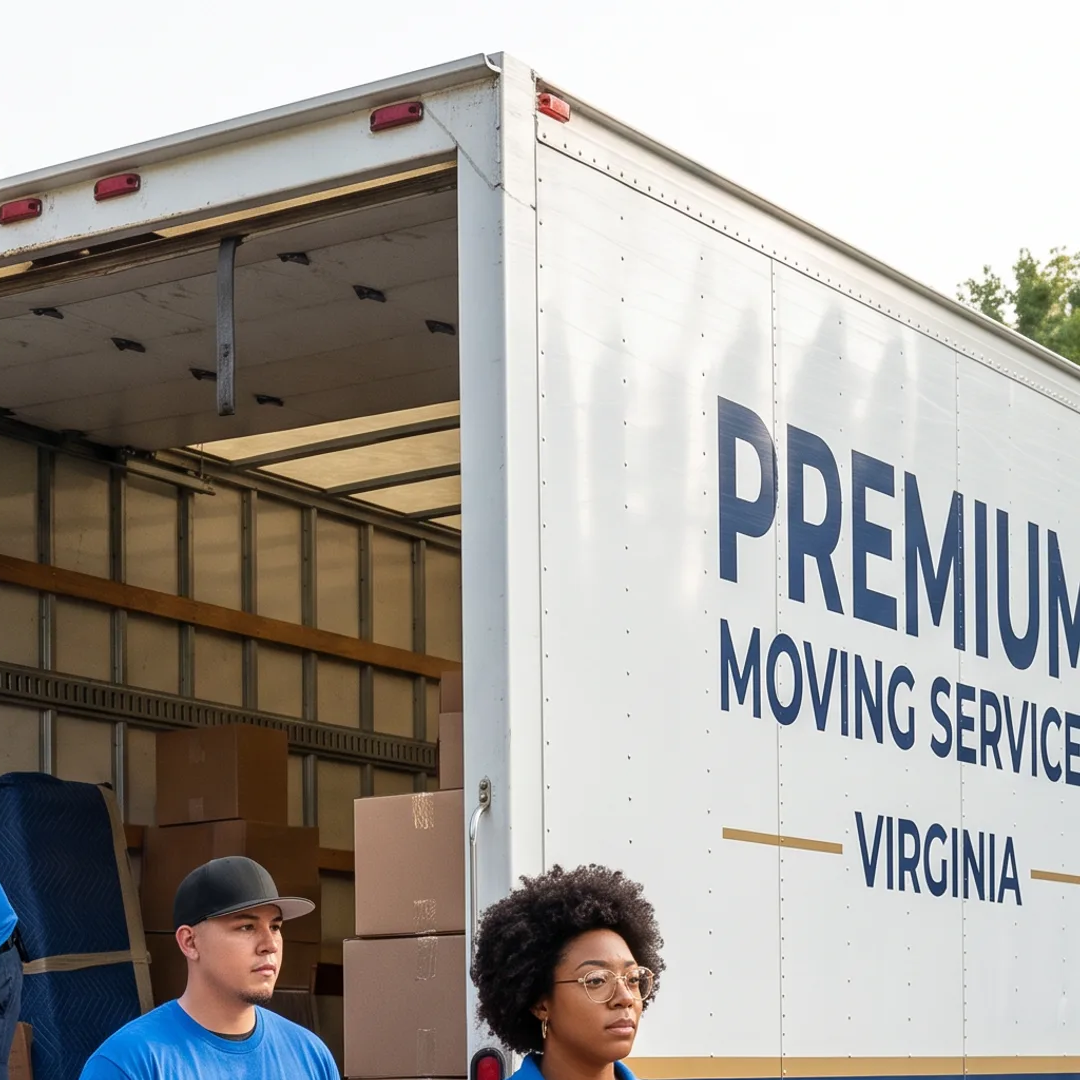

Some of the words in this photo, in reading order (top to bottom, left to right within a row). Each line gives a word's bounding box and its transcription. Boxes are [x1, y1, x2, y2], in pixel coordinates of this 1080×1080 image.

[718, 396, 1080, 679] PREMIUM
[720, 618, 916, 751] MOVING
[855, 811, 1023, 906] VIRGINIA
